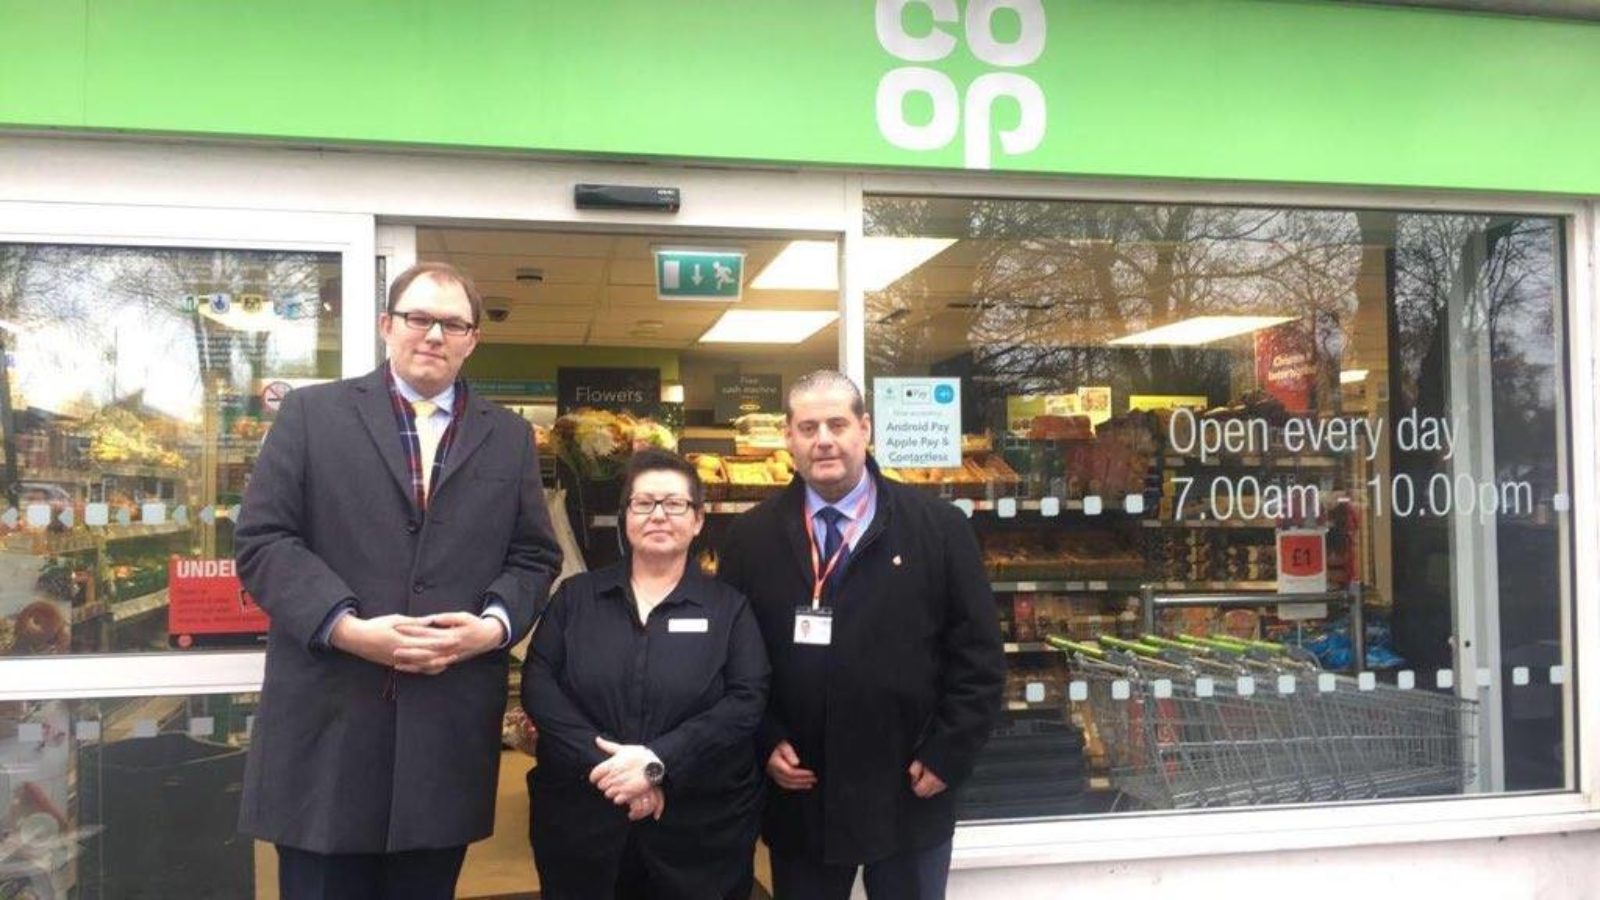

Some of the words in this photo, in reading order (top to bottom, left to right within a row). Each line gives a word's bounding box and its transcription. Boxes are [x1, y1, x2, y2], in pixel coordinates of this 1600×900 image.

[575, 385, 643, 403] Flowers
[886, 421, 928, 432] Android
[931, 421, 949, 433] Pay
[1169, 407, 1269, 462] Open
[1283, 414, 1383, 460] every
[1397, 407, 1460, 459] day
[886, 437, 918, 449] Apple
[921, 437, 939, 449] Pay
[942, 437, 949, 446] &
[888, 452, 949, 463] Contactless
[1169, 475, 1321, 521] 7.00am
[1367, 472, 1533, 526] 10.00pm
[1292, 547, 1311, 567] £1
